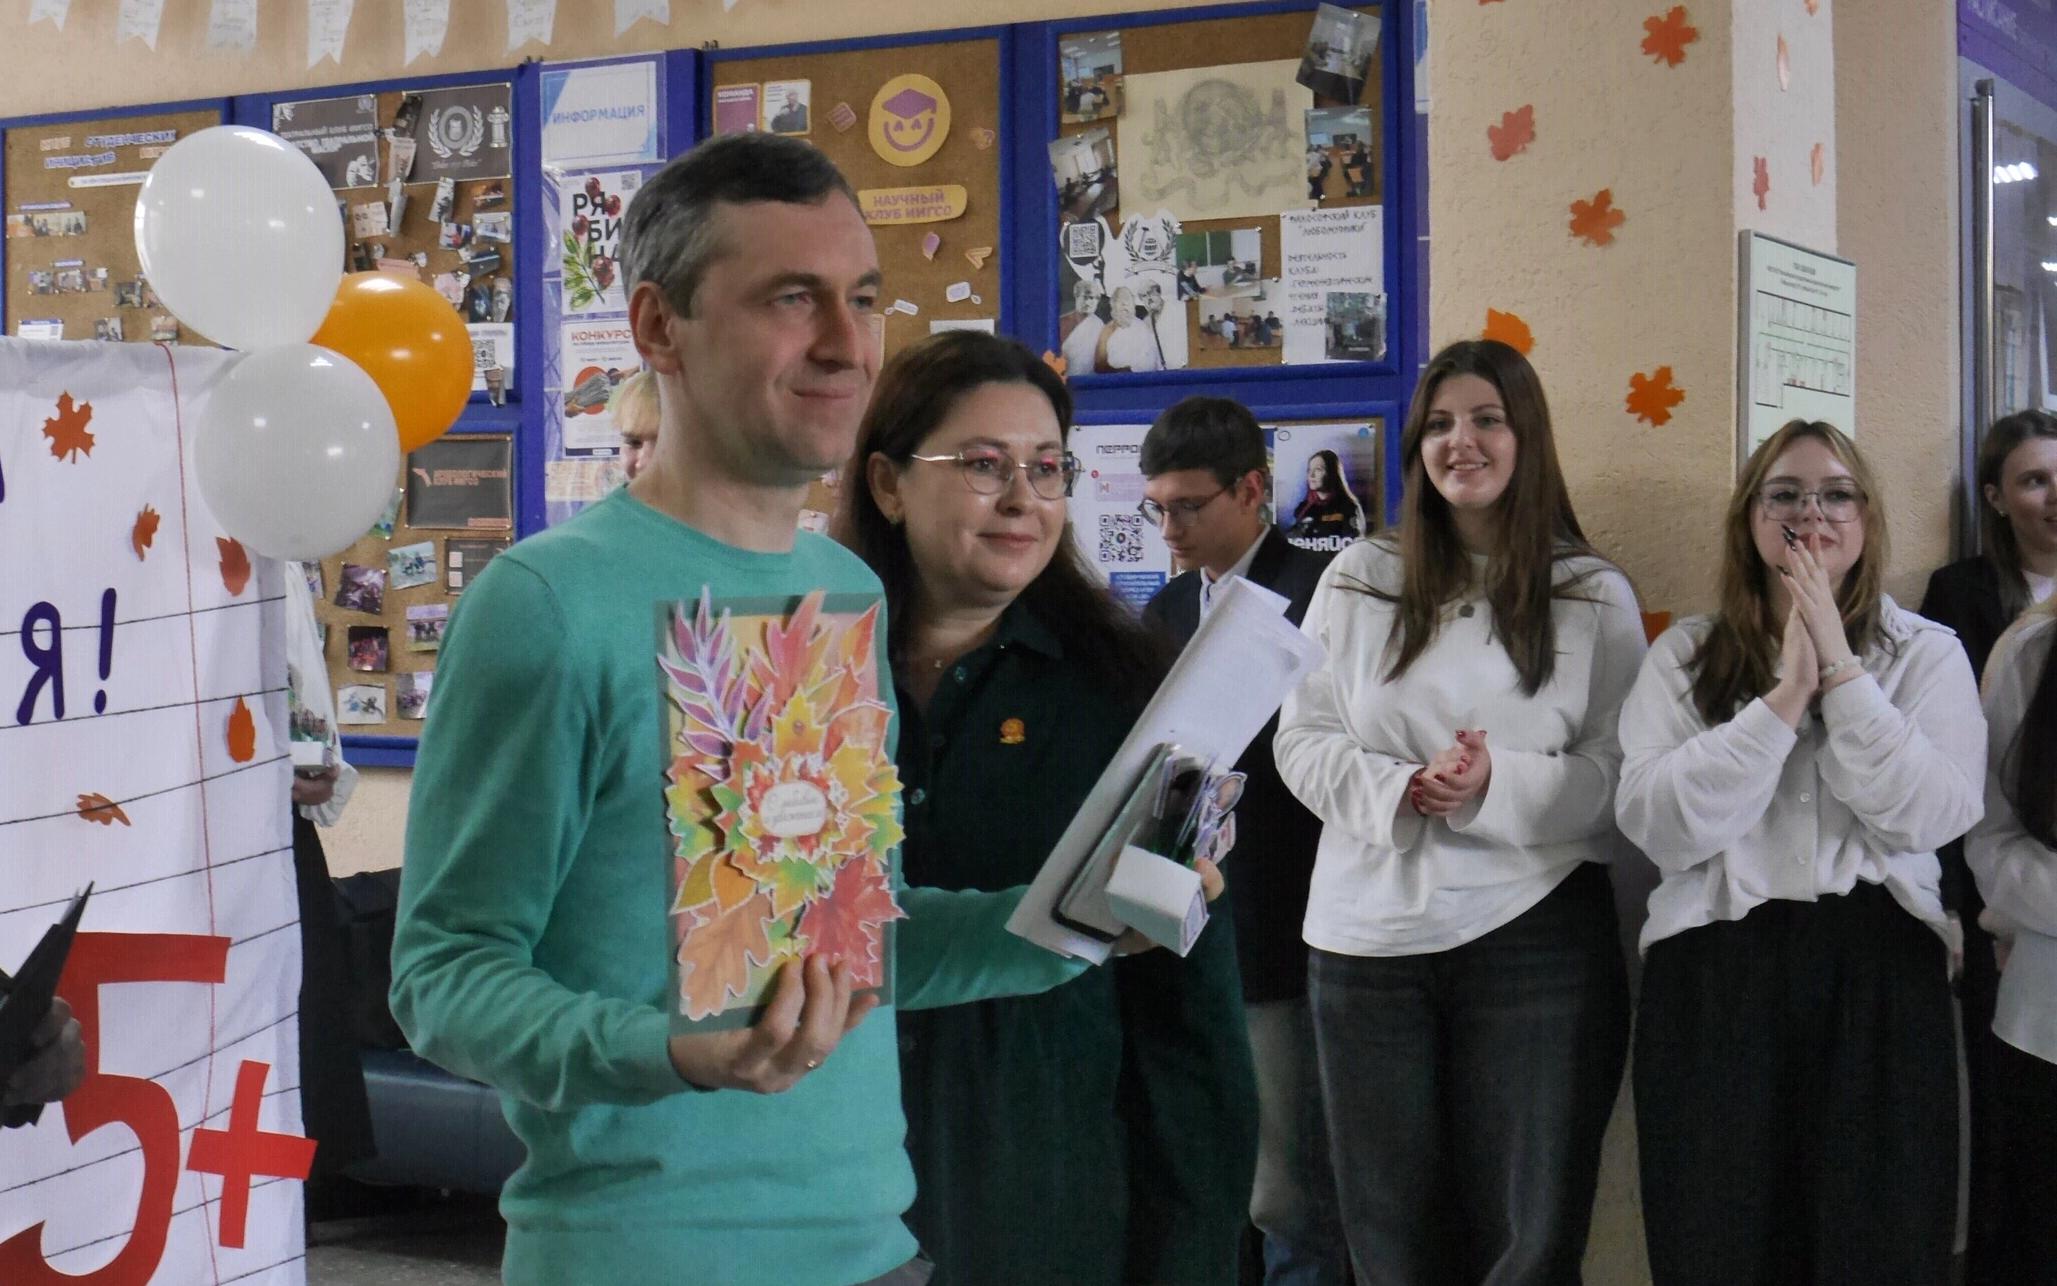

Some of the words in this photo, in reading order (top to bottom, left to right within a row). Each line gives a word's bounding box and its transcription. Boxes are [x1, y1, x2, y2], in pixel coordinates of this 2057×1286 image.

[552, 105, 645, 124] ИНФОРМАЦИЯ
[573, 191, 606, 216] РЯ
[873, 189, 945, 207] НАУЧНЫЙ
[587, 217, 623, 241] БИ
[571, 329, 632, 341] КОНКУРС
[1096, 444, 1142, 454] ПЕРРО
